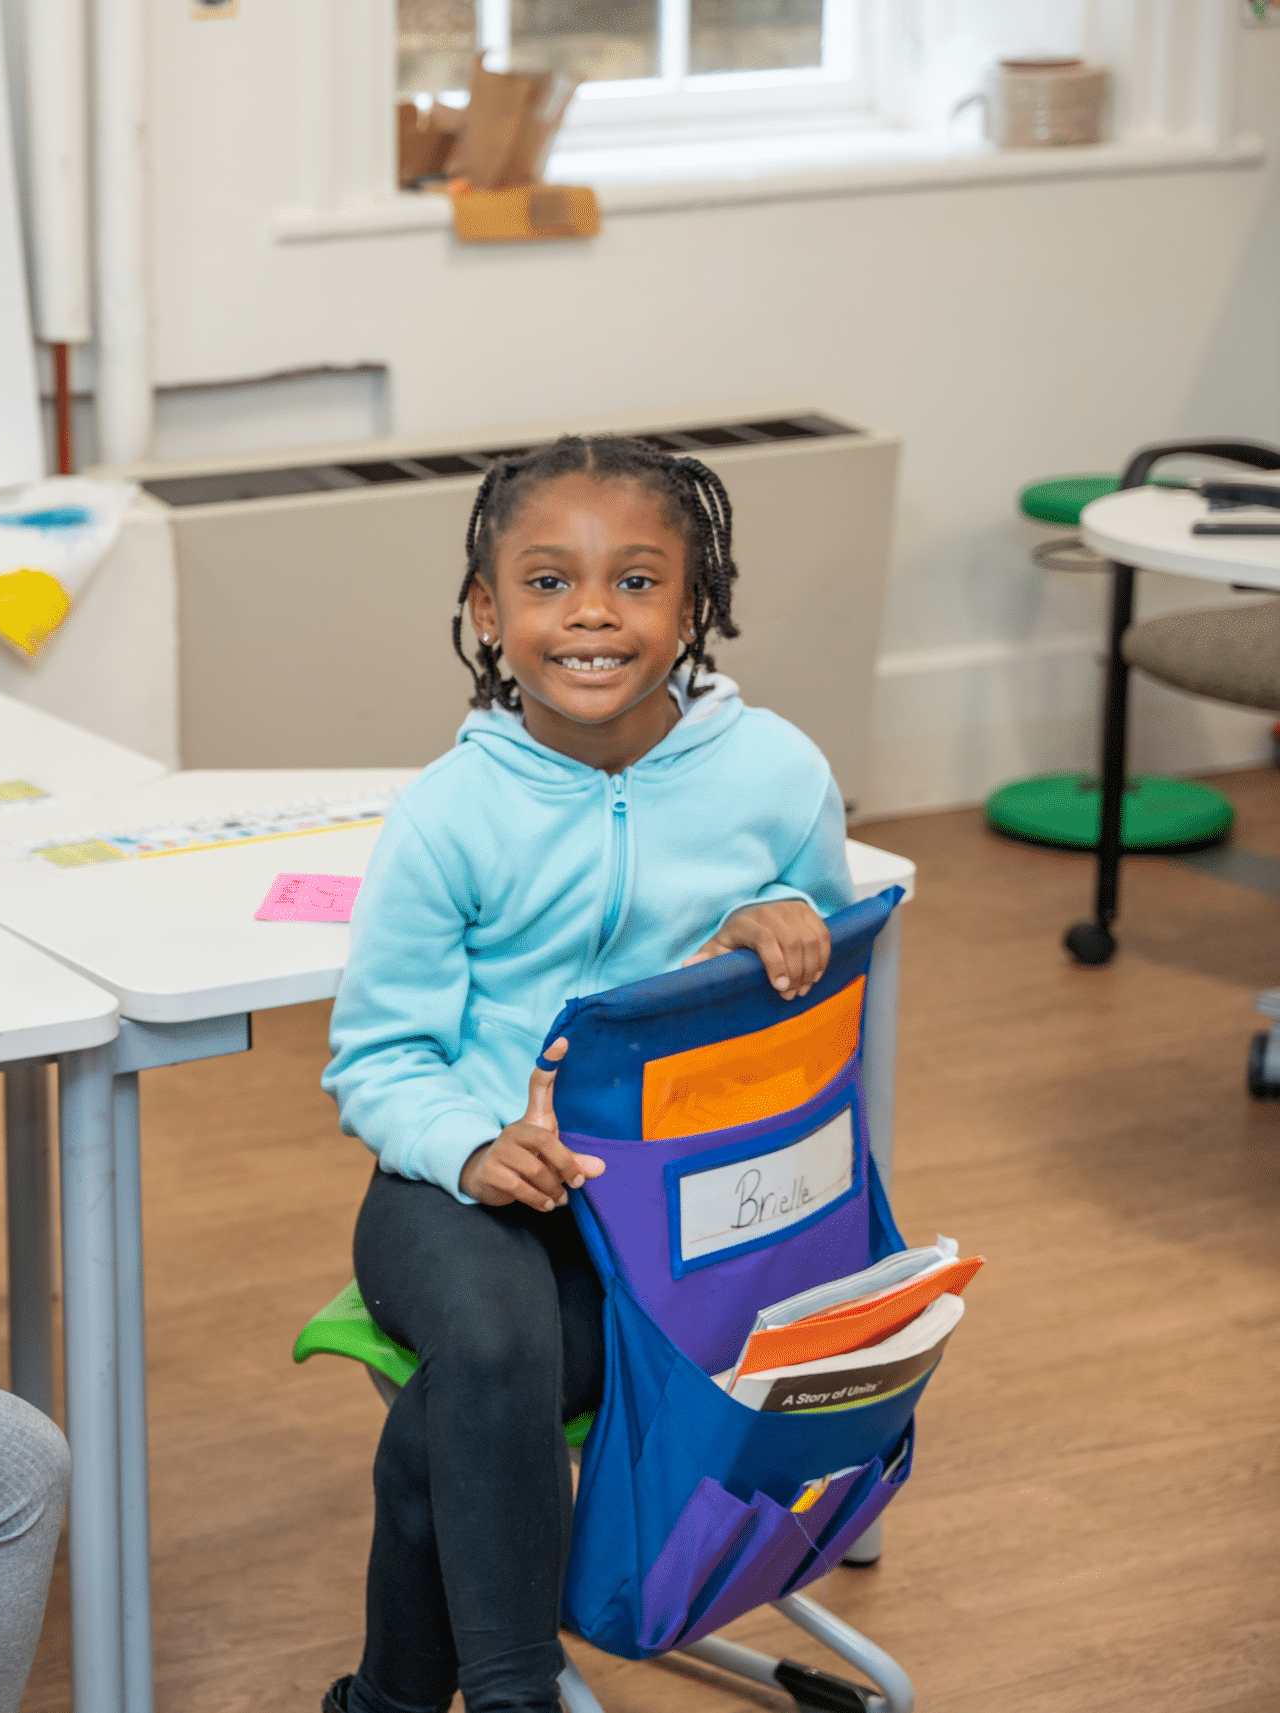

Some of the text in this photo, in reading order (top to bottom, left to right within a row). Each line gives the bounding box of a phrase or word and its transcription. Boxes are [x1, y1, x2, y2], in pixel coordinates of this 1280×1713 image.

[730, 1168, 813, 1229] Brielle
[781, 1394, 794, 1406] A
[795, 1393, 831, 1405] Story
[831, 1387, 848, 1400] of
